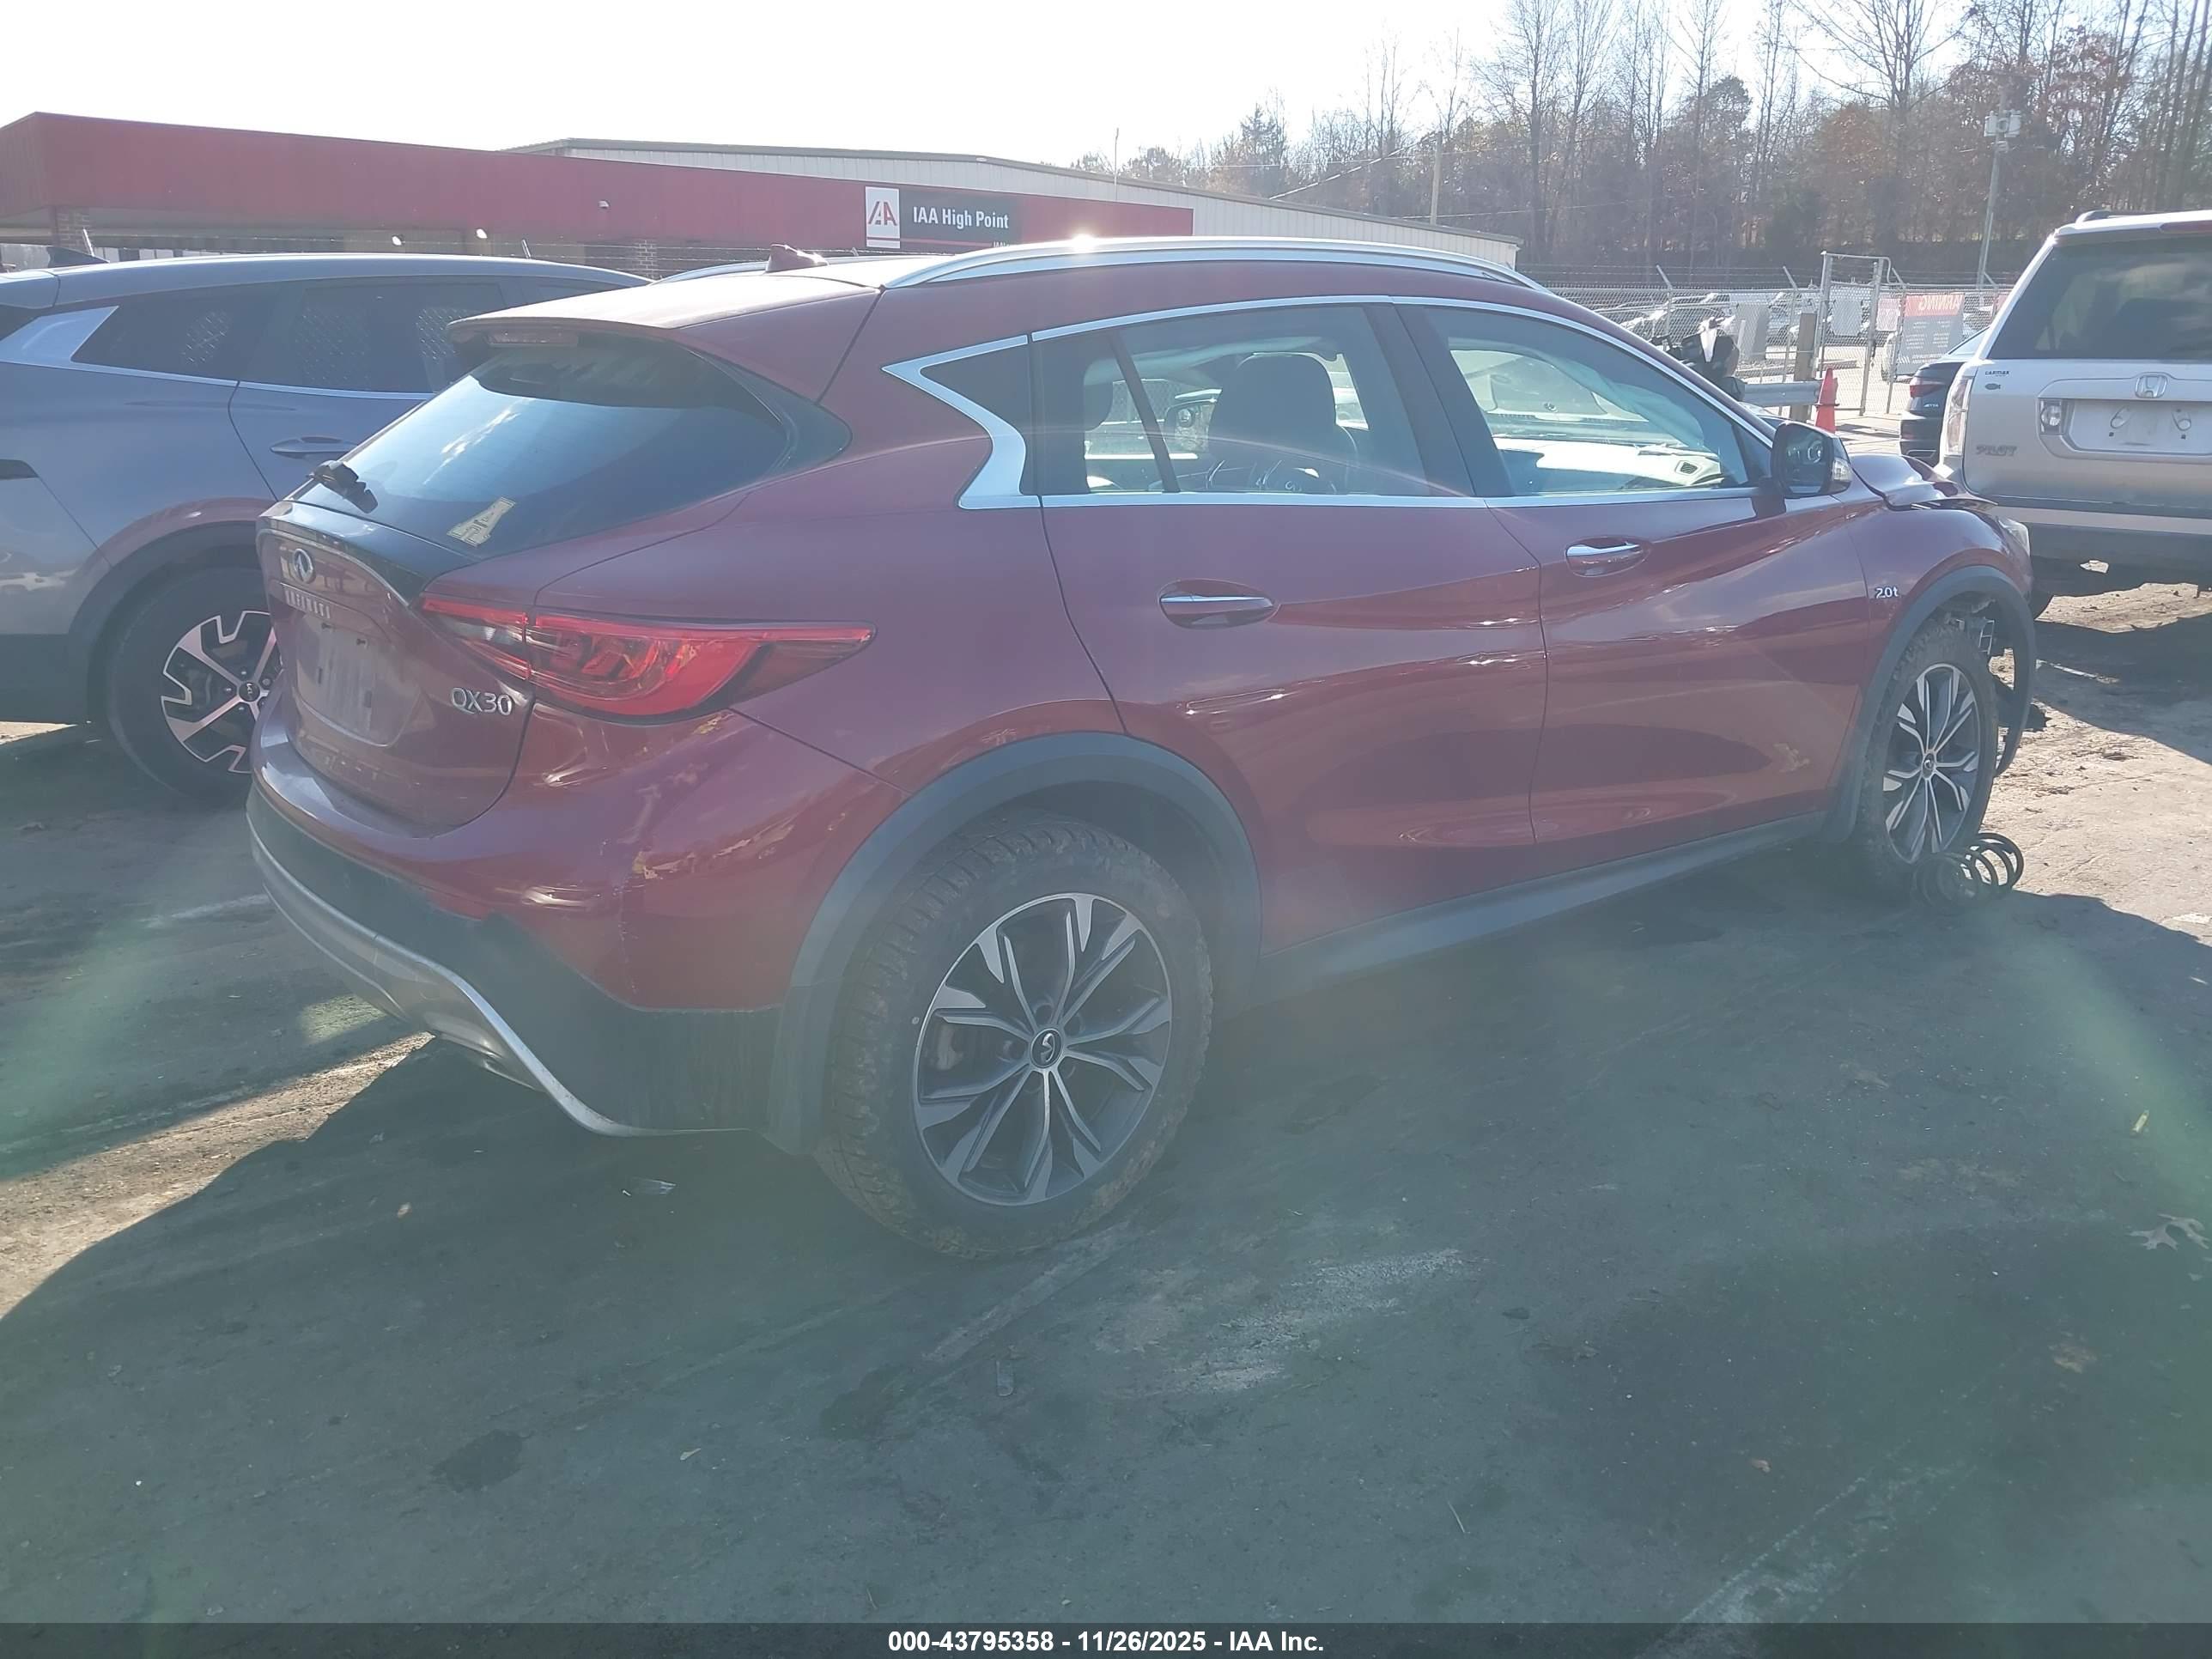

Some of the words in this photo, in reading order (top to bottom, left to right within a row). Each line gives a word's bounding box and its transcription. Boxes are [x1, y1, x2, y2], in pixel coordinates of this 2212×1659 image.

[913, 206, 939, 224] IAA
[942, 208, 972, 229] High
[975, 210, 1009, 229] Point
[451, 686, 514, 716] QX30
